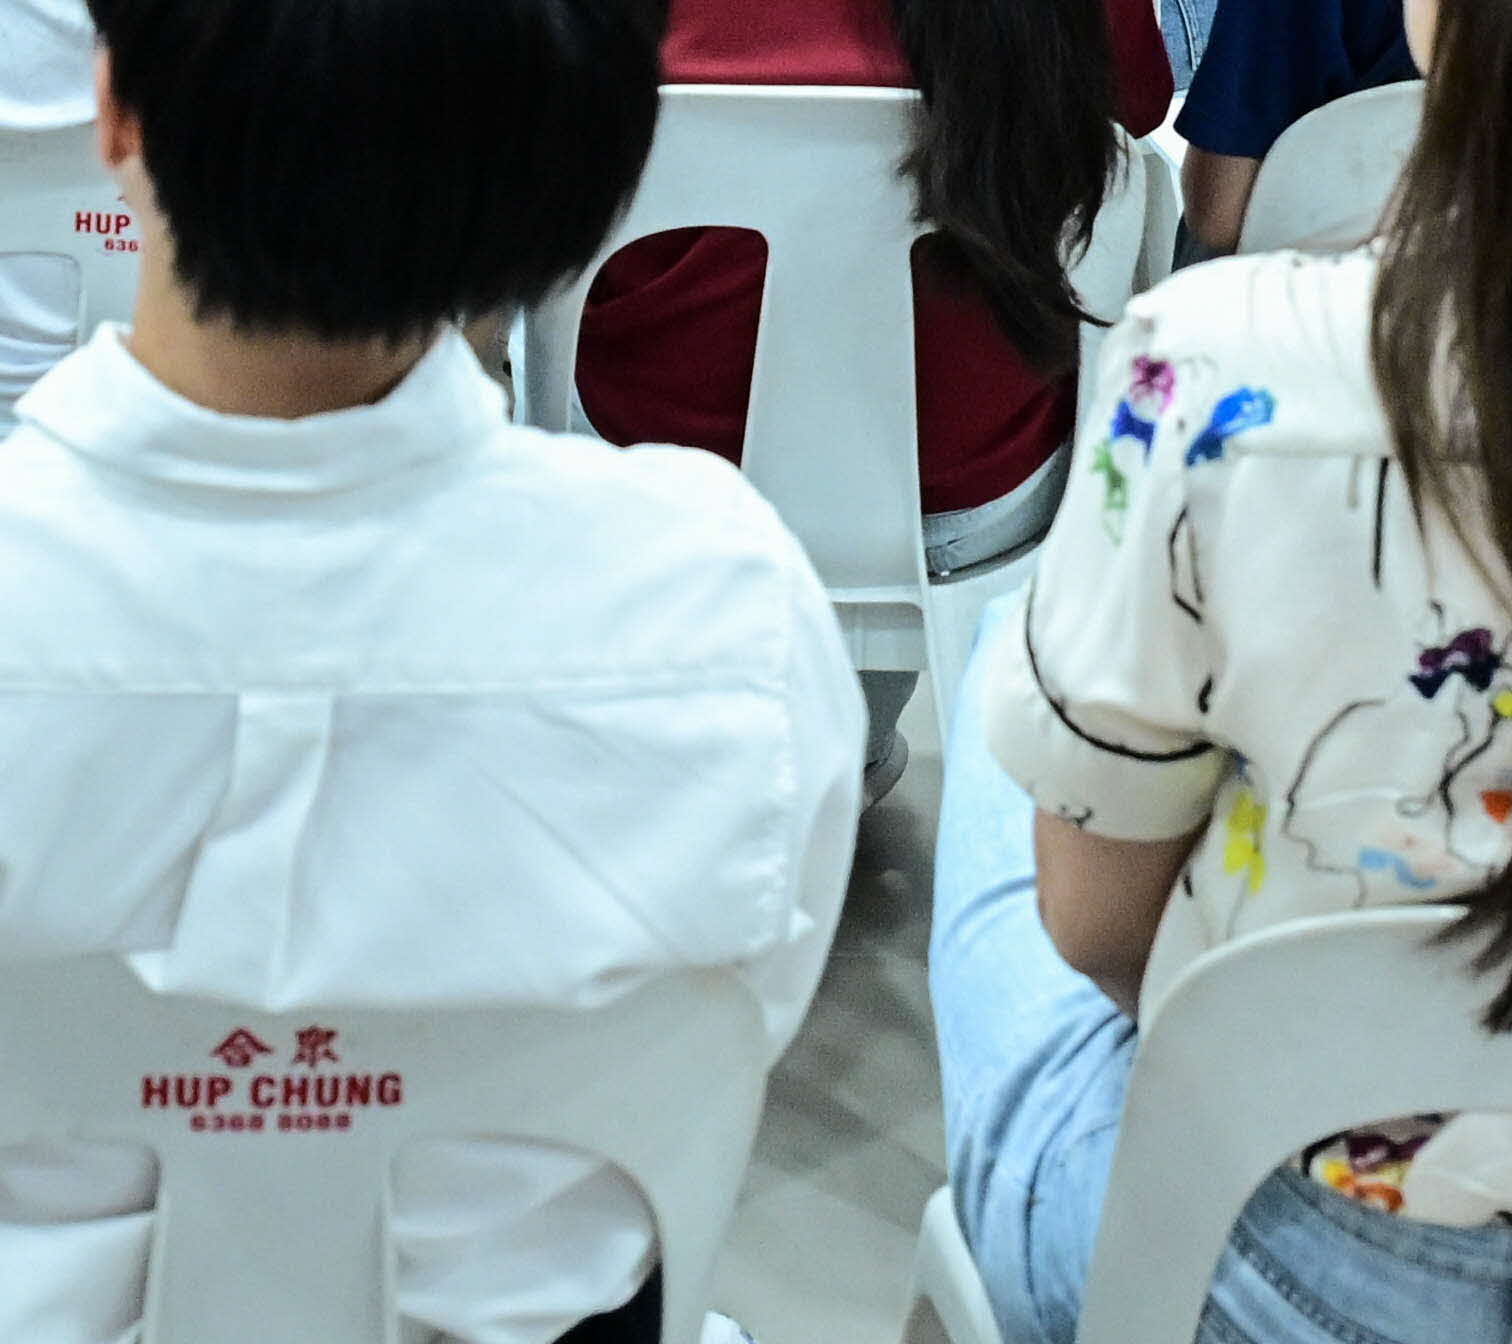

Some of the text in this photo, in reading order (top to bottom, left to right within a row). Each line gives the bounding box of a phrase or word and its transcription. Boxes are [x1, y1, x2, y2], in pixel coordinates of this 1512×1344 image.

[75, 211, 130, 234] HUP
[105, 239, 139, 251] 636
[142, 1072, 401, 1108] HUP CHUNG
